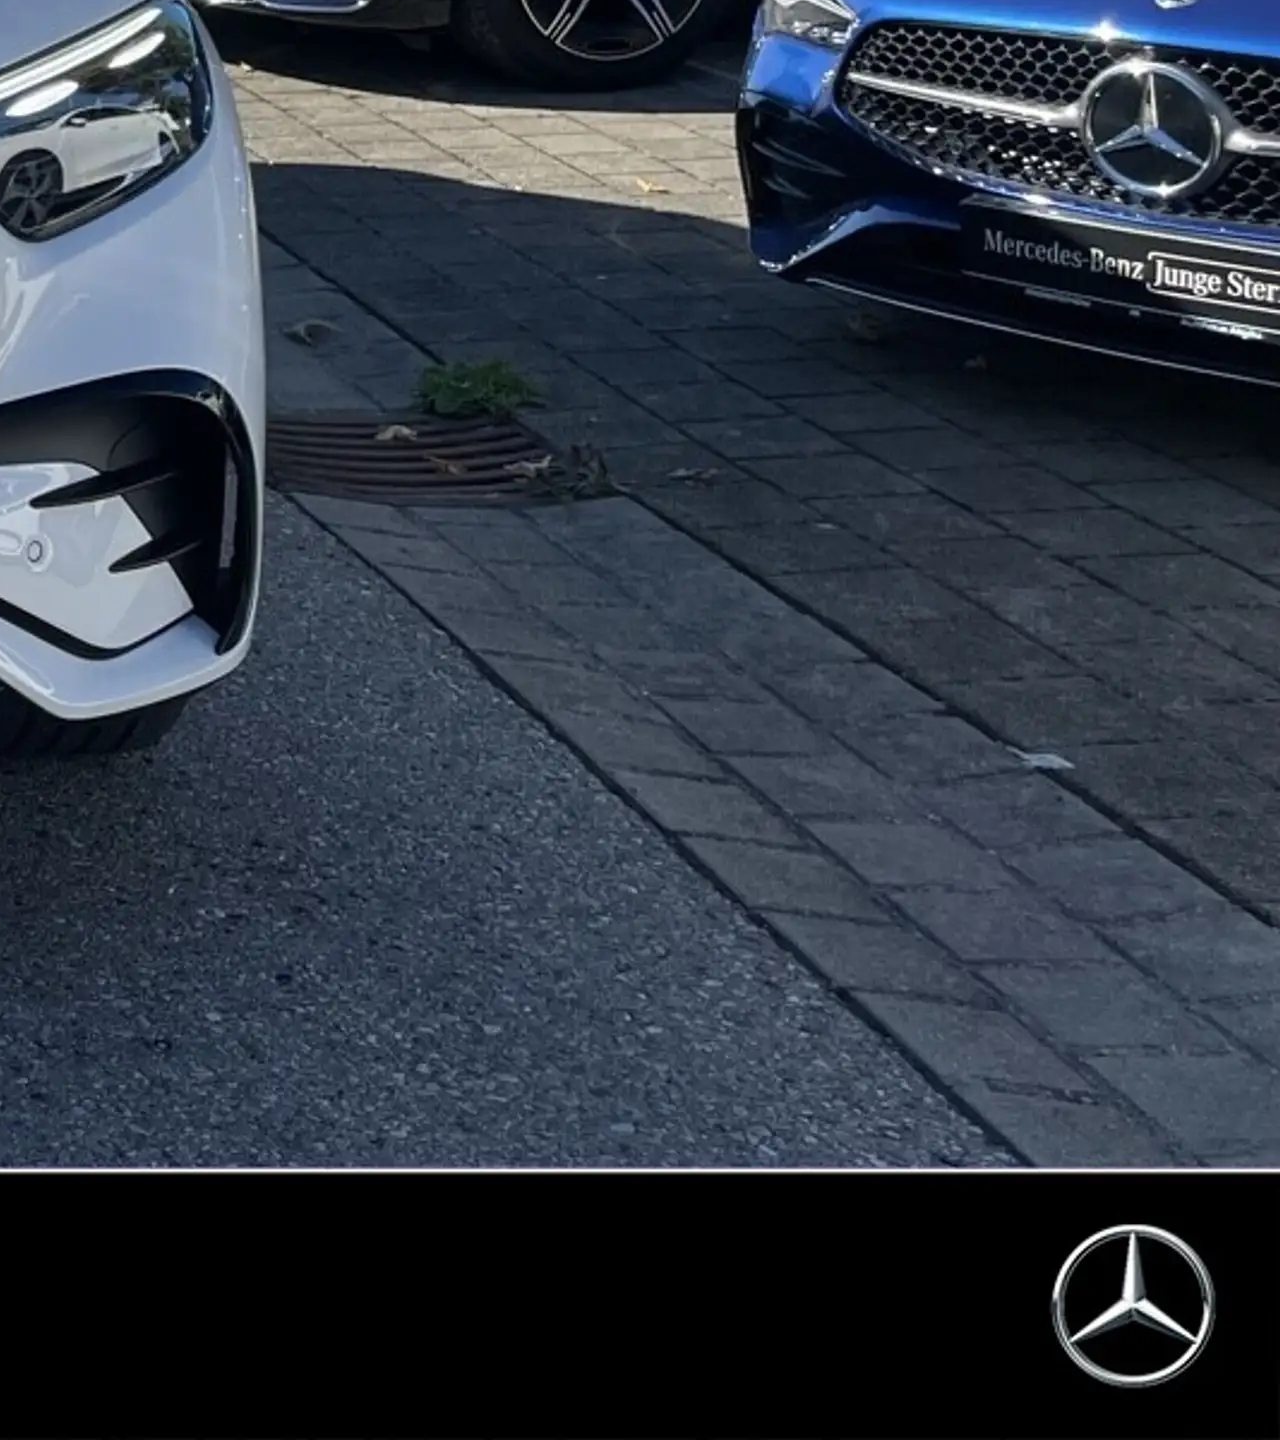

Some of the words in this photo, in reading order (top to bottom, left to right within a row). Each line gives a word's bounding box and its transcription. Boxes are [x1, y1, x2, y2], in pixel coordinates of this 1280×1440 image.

[984, 229, 1144, 280] Mercedes-Benz
[1153, 259, 1222, 296] Junge
[1226, 270, 1280, 303] Ster
